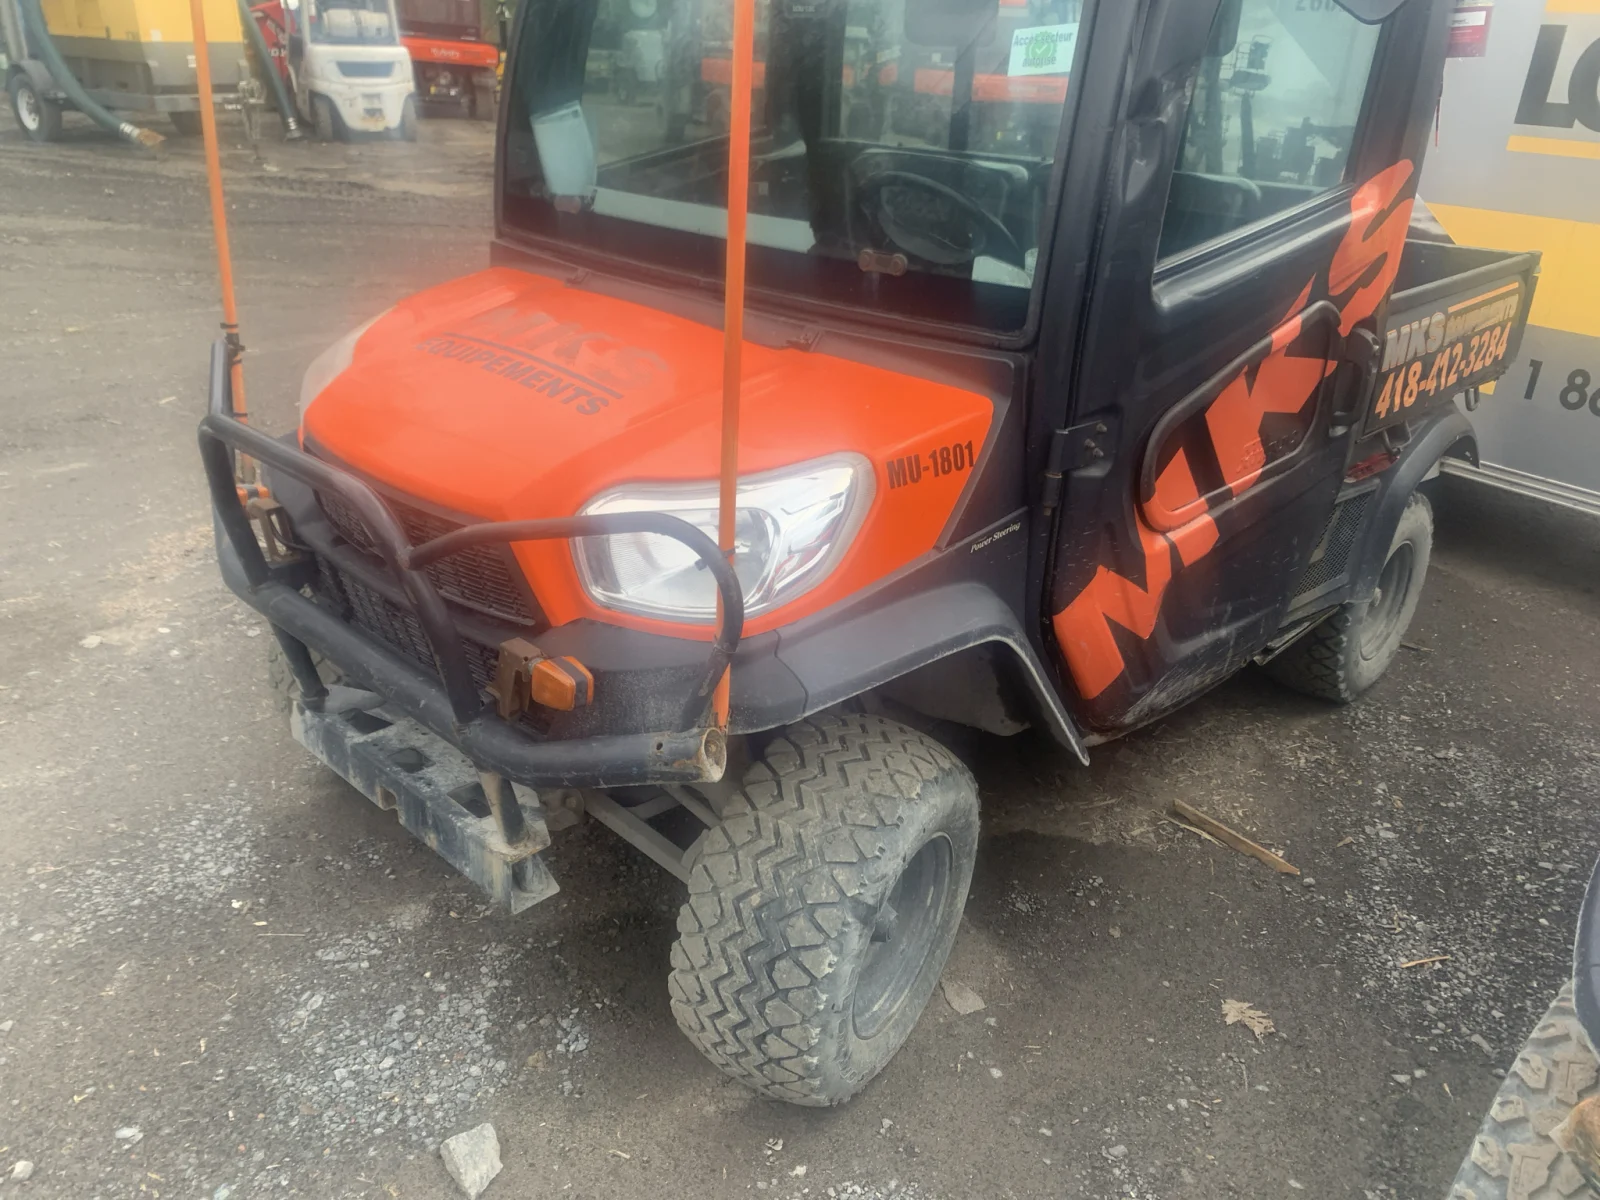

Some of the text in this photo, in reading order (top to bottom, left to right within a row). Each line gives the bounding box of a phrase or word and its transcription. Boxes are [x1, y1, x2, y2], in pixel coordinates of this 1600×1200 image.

[1375, 321, 1512, 419] 418-412-3284
[1381, 312, 1446, 373] MKS
[415, 336, 609, 415] EQUIPEMENTS
[1524, 358, 1543, 400] 1
[1052, 158, 1415, 700] MKS
[886, 440, 974, 489] MU-1801
[970, 521, 1021, 553] Power Steering
